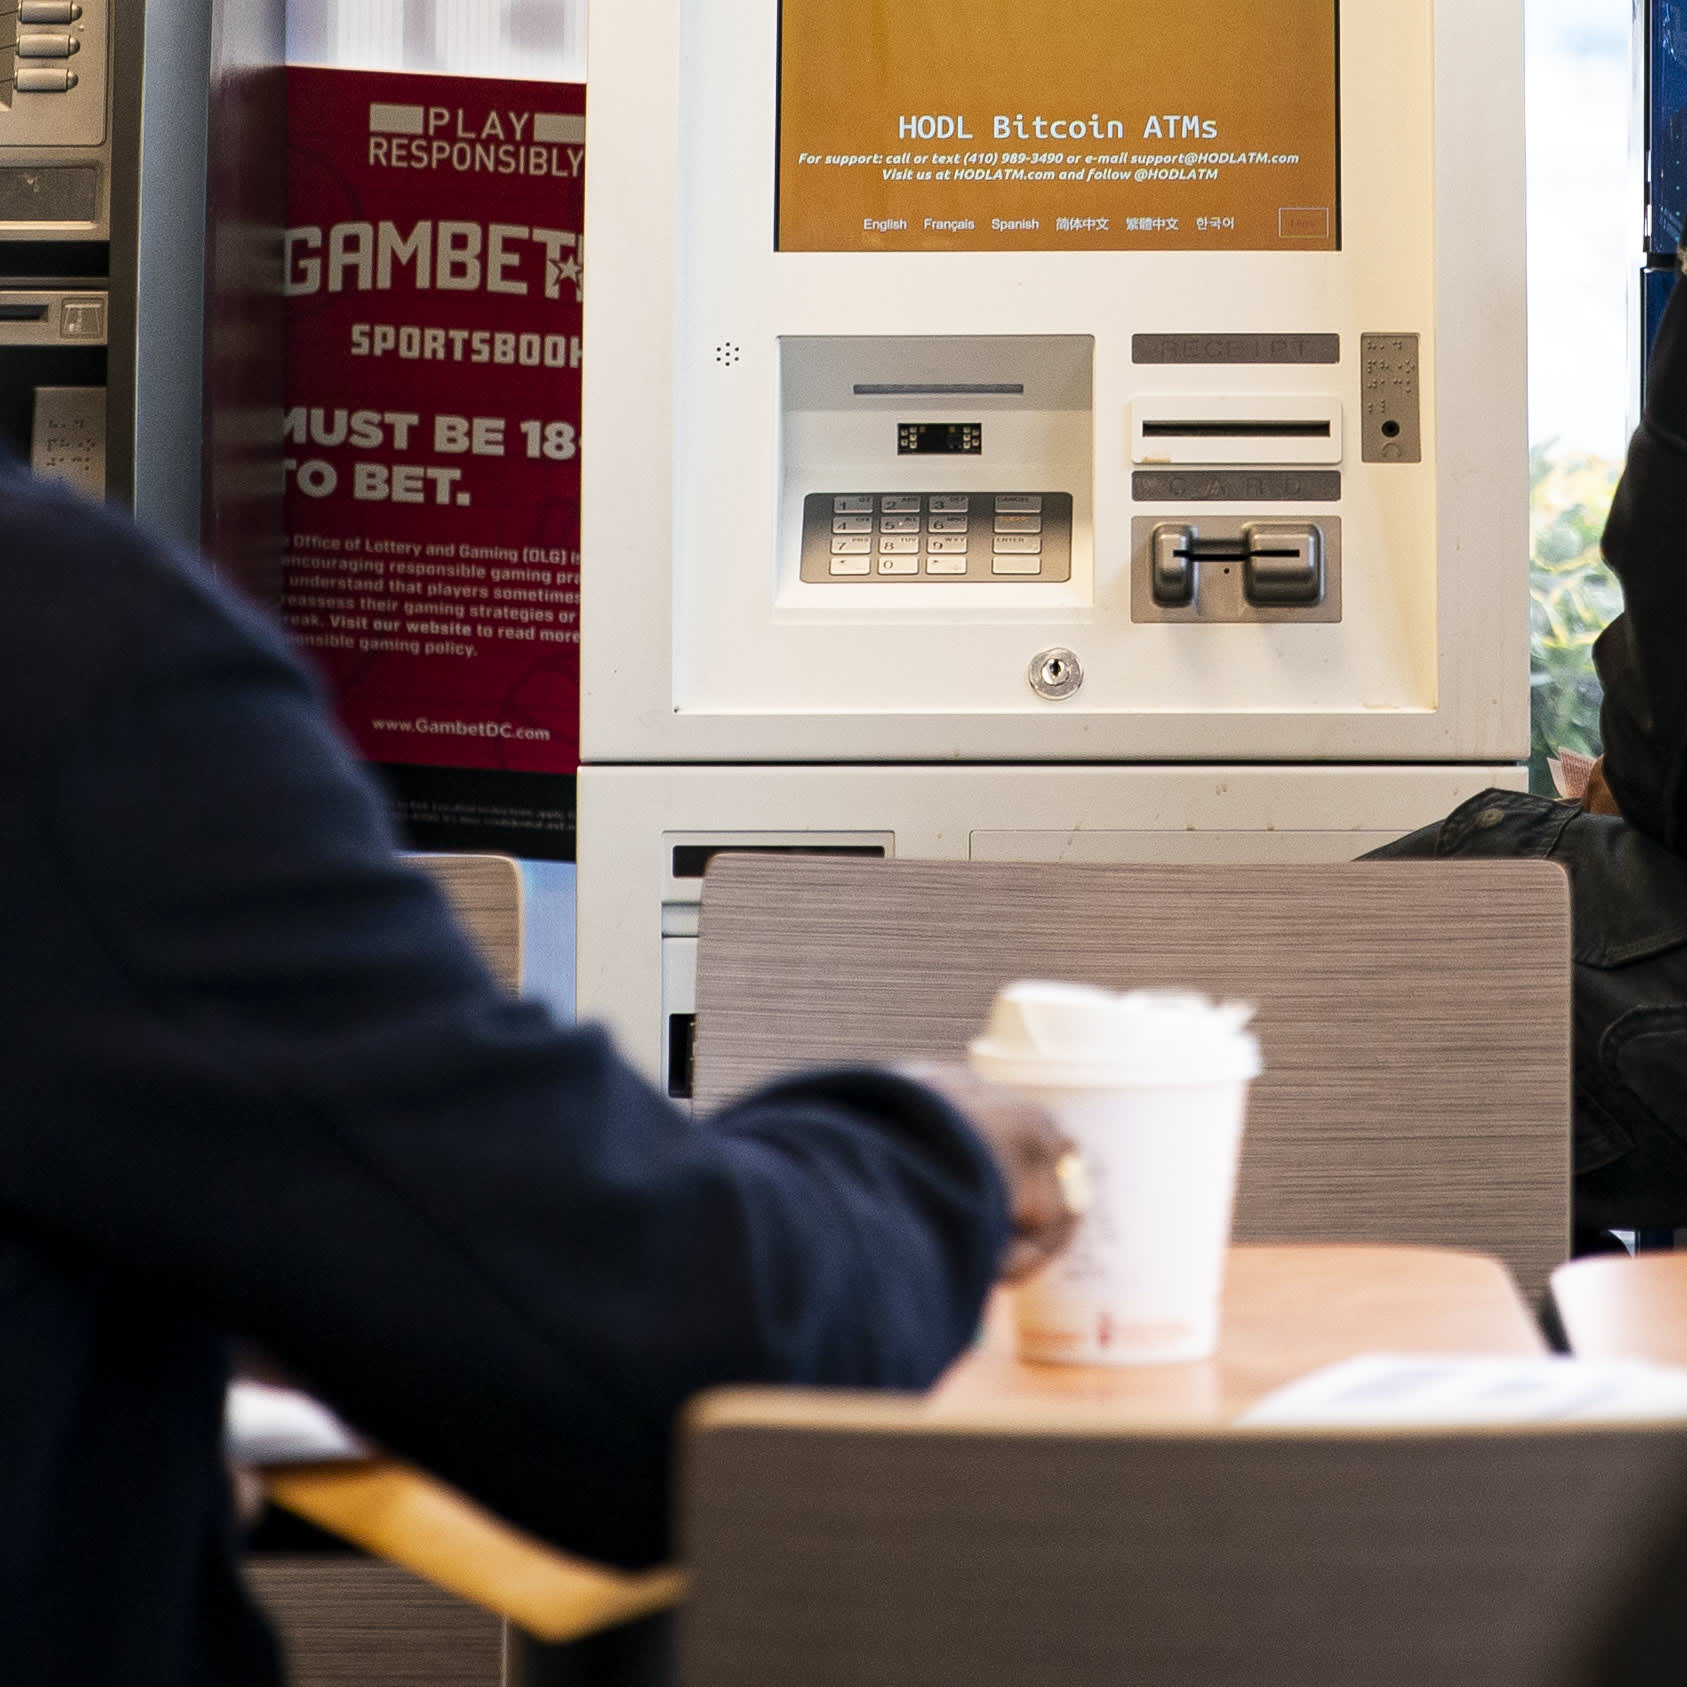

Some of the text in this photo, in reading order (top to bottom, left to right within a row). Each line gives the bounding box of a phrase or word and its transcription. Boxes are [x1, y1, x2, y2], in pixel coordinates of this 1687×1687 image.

[428, 106, 529, 141] PLAY
[898, 113, 1218, 140] HODL Bitcoin ATMs
[369, 136, 584, 177] RESPONSIBLY
[799, 152, 1299, 167] For support: call or text (410) 989-3490 or e-mail support@HODLATM.com
[882, 169, 1218, 182] Visit us at HODLATM.com and follow @HODLATM
[864, 218, 1039, 232] English Français Spanish
[1197, 217, 1234, 230] 한국어
[434, 415, 505, 456] BE
[353, 463, 470, 506] BET.
[373, 718, 550, 741] www.GambetDC.com
